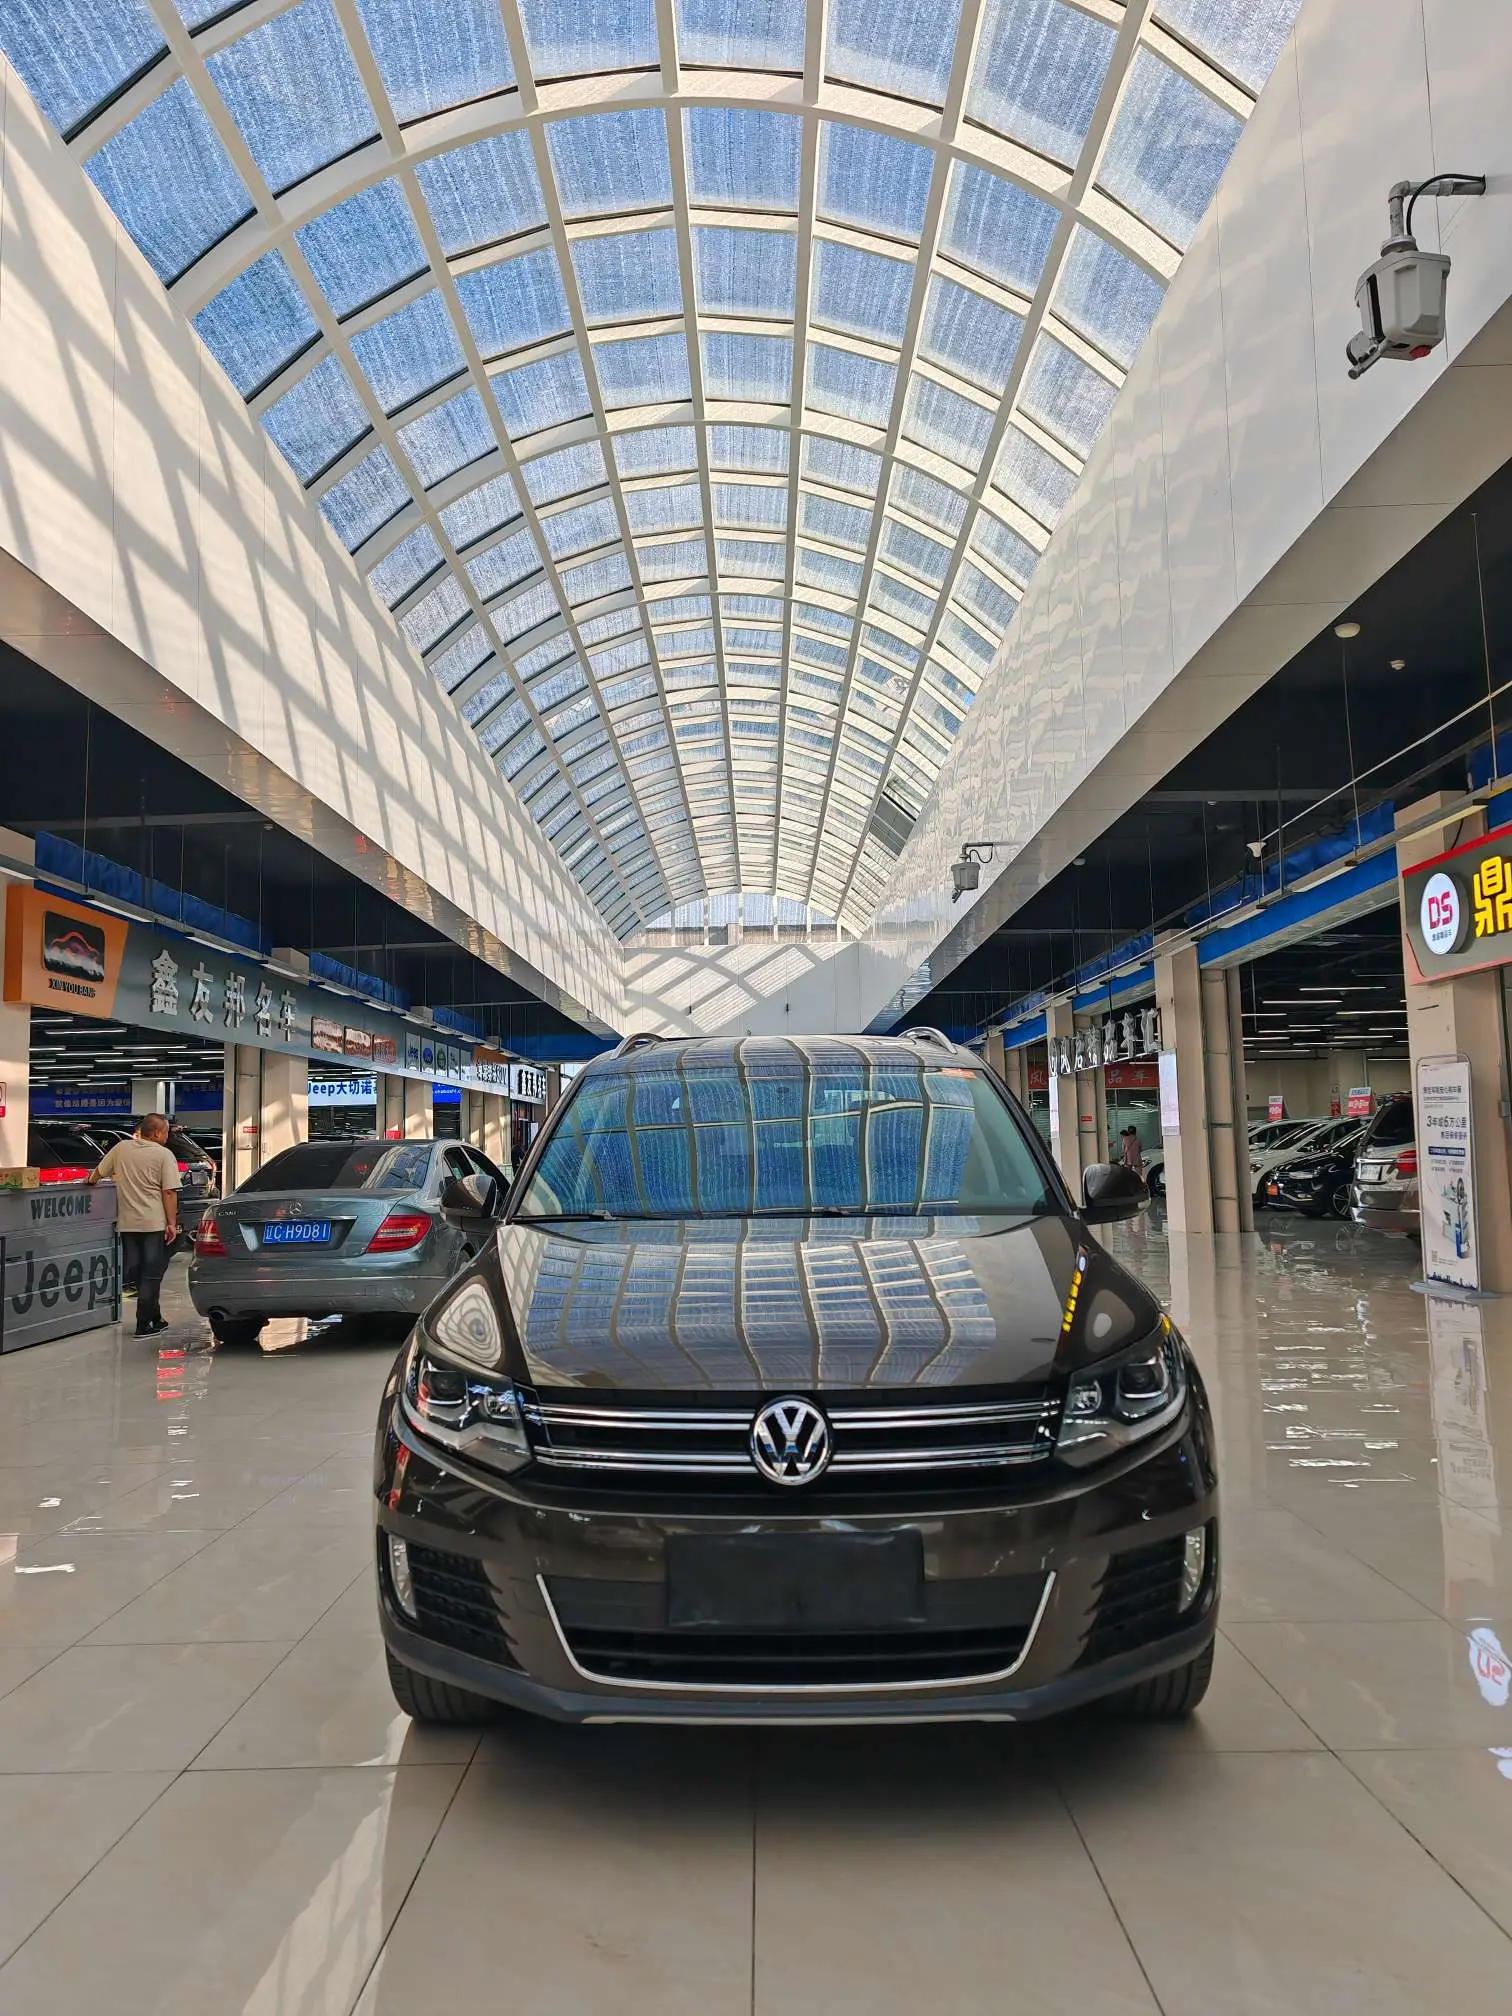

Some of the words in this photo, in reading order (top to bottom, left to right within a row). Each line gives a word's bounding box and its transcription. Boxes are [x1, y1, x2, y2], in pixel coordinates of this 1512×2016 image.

[1427, 891, 1453, 930] DS
[1474, 857, 1512, 938] 鼎
[151, 949, 297, 1042] 鑫友邦名车
[308, 1080, 377, 1096] Jeep大切诺
[31, 1194, 92, 1220] WELCOME
[12, 1250, 109, 1314] Jeep
